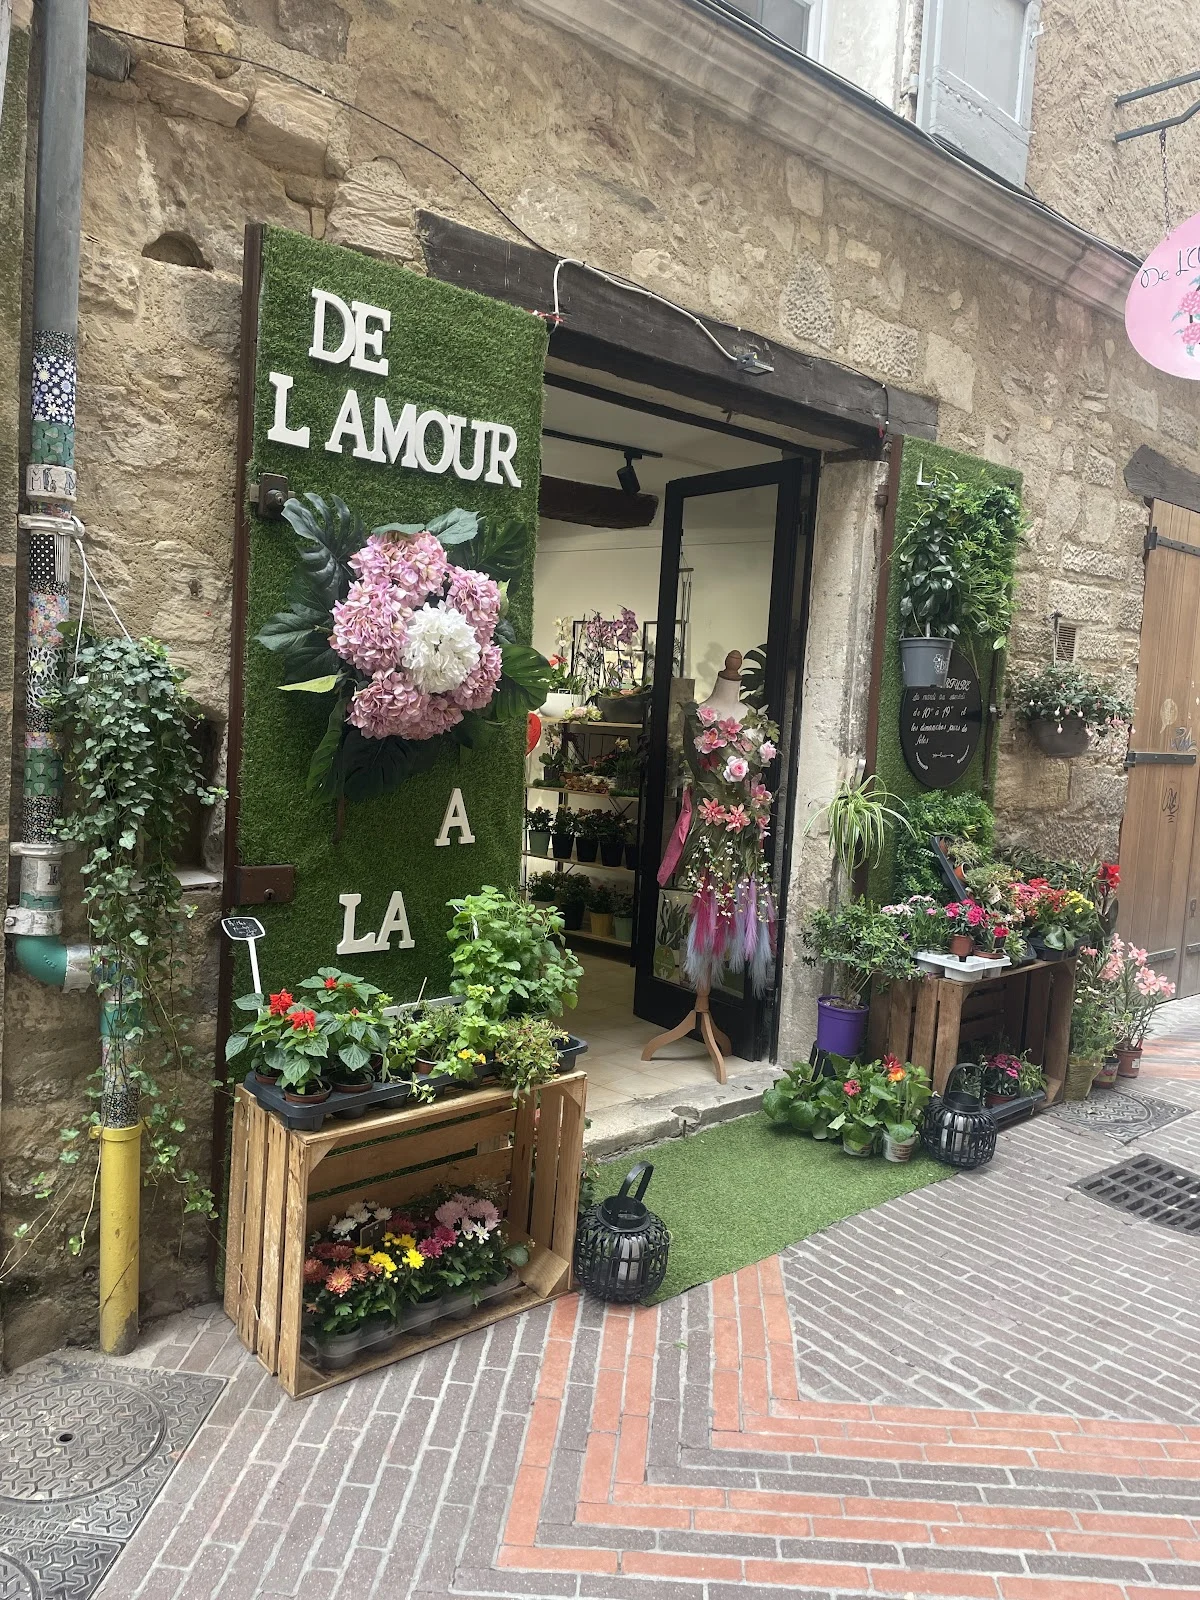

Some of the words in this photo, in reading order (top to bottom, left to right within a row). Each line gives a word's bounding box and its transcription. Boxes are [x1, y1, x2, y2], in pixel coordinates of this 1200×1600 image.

[1140, 267, 1171, 288] De
[308, 288, 391, 377] DE
[267, 371, 310, 449] L
[324, 389, 522, 488] AMOUR
[913, 708, 920, 716] de
[920, 722, 946, 731] dimanches
[434, 788, 476, 847] A
[336, 890, 416, 955] LA
